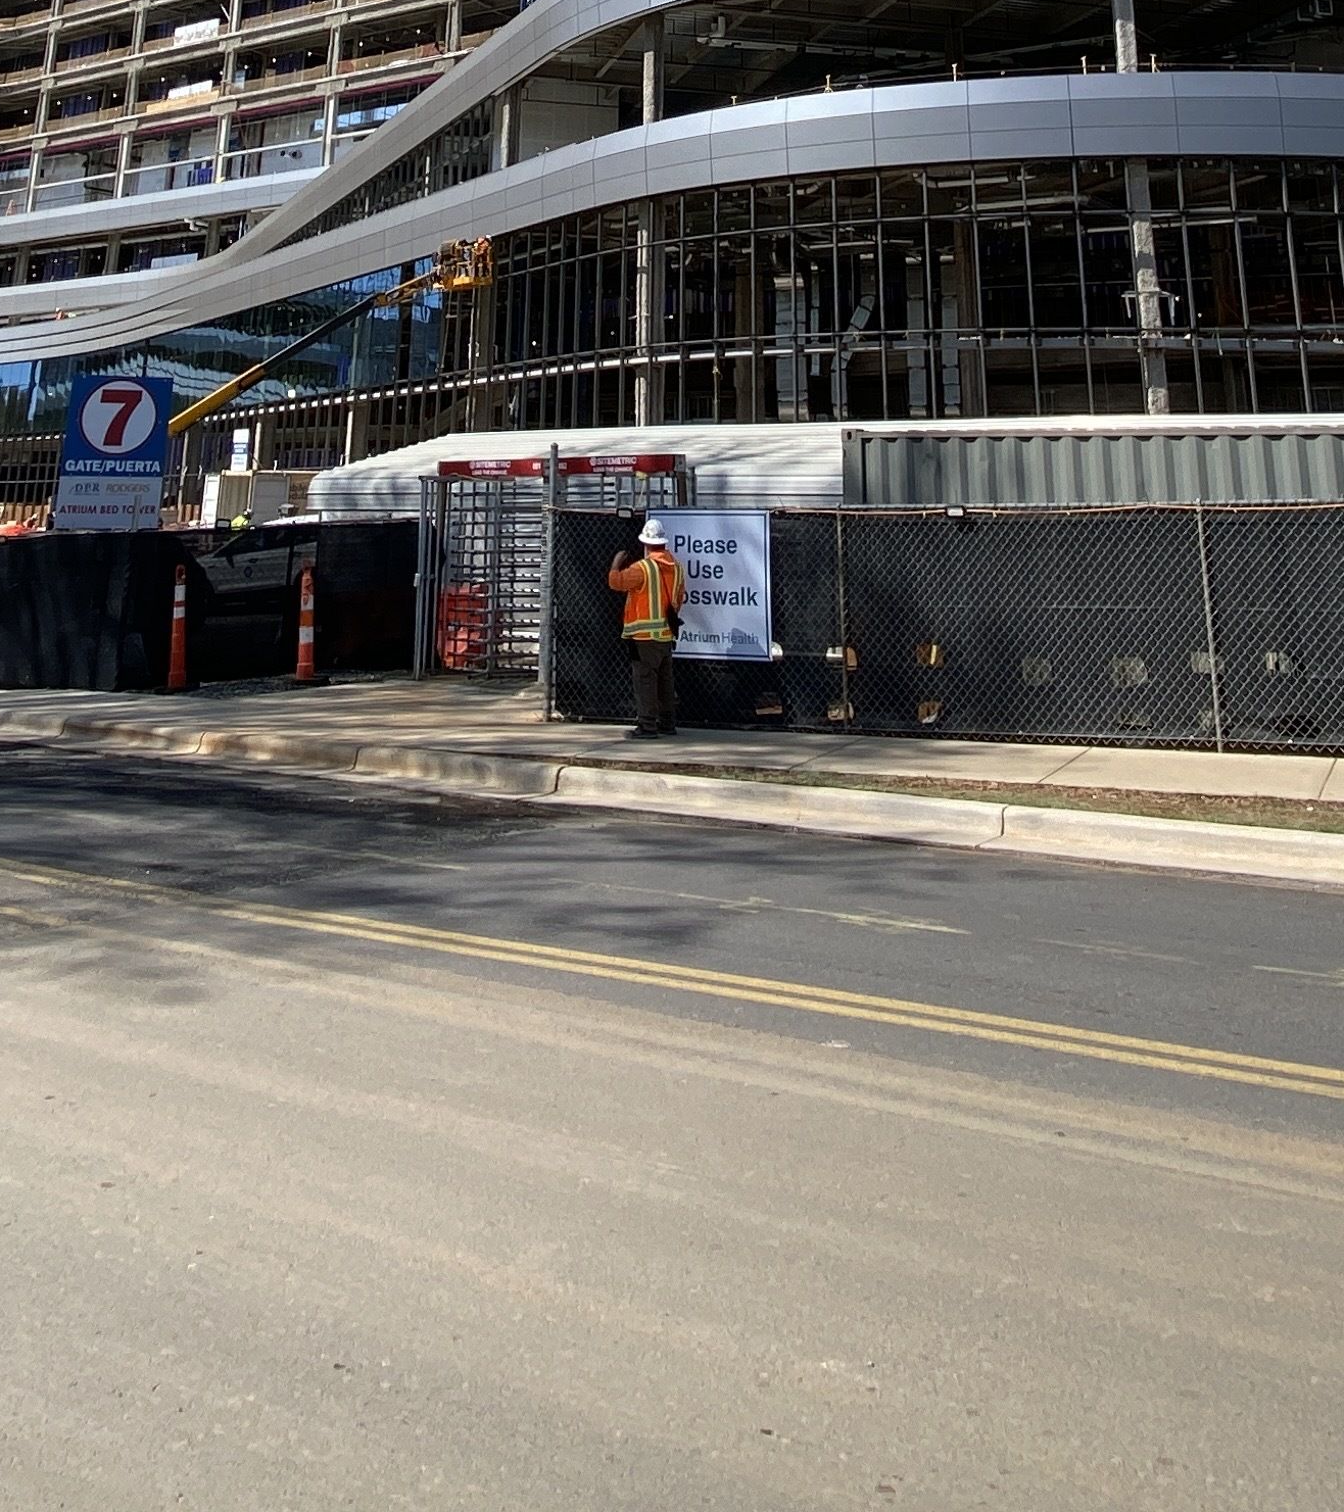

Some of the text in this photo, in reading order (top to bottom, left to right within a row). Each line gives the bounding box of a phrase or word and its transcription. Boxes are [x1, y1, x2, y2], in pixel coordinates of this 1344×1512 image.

[100, 389, 143, 446] 7
[65, 459, 161, 474] GATE/PUERTA
[106, 483, 151, 493] RODGERS
[59, 505, 97, 514] ATRIUM
[100, 505, 119, 514] BED
[674, 535, 738, 554] Please
[688, 560, 724, 579] Use
[682, 587, 758, 606] osswalk
